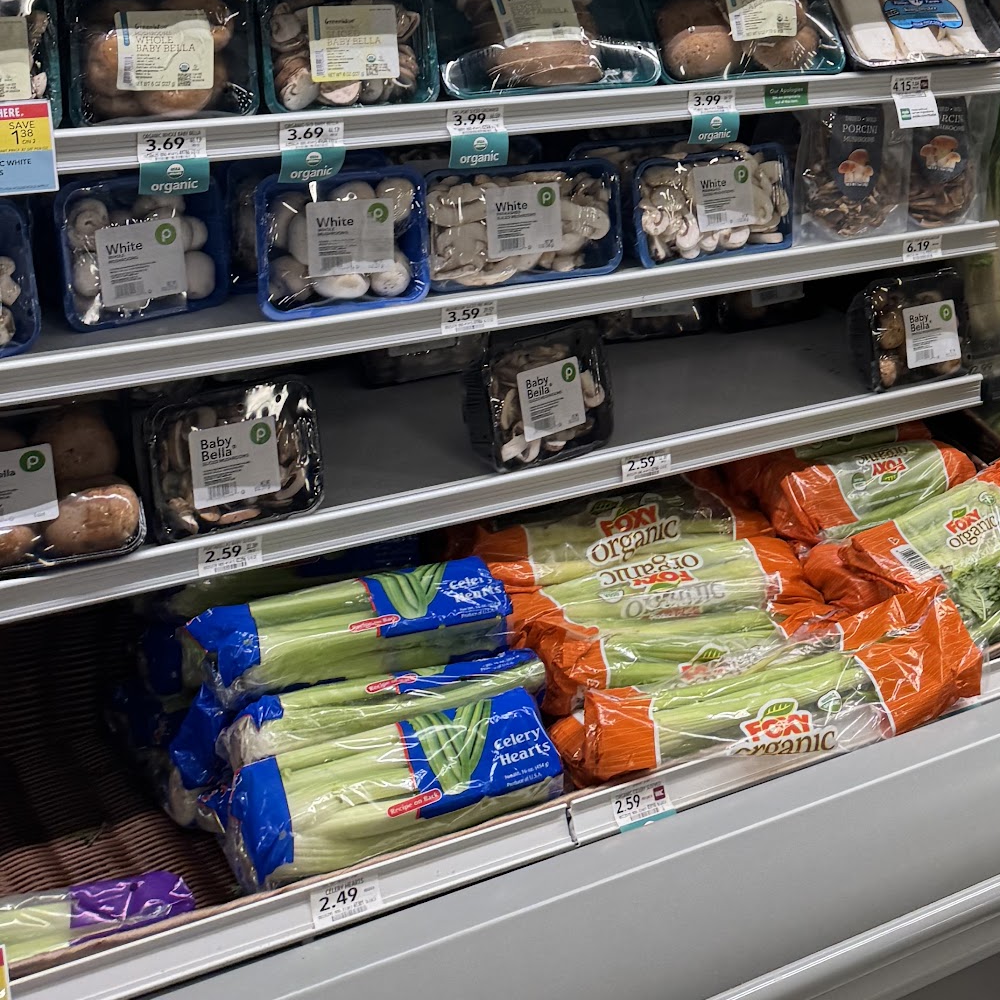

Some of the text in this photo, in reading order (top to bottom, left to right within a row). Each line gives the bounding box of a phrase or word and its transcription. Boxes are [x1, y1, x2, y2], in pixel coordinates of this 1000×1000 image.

[136, 36, 174, 44] WHOLE
[136, 43, 196, 52] BABY BELLA
[693, 95, 721, 106] 3.99
[9, 120, 35, 130] SAVE
[453, 113, 486, 126] 3.99
[287, 126, 324, 141] 3.69
[698, 129, 731, 141] organic
[842, 124, 878, 134] PORCINI
[145, 136, 185, 152] 3.69
[6, 158, 31, 166] WHITE
[459, 150, 500, 165] organic
[290, 166, 332, 180] organic
[150, 177, 198, 193] organic
[701, 178, 726, 189] White
[495, 200, 528, 212] White
[316, 216, 354, 228] White
[106, 240, 143, 256] White
[907, 241, 930, 253] 6.19
[447, 308, 480, 323] 3.59
[909, 314, 929, 324] Baby
[911, 323, 930, 332] Bella
[526, 375, 549, 389] Baby
[527, 386, 550, 399] Bella
[200, 437, 232, 451] Baby
[201, 448, 232, 462] Bella
[628, 456, 656, 472] 2.59
[873, 458, 907, 476] FOXY
[600, 505, 657, 538] FOXY
[946, 509, 981, 534] FOXY
[949, 516, 1000, 548] organic
[592, 519, 678, 562] organic
[205, 545, 242, 563] 2.59
[449, 575, 492, 591] Celery
[745, 714, 809, 742] FOXY
[494, 727, 541, 751] Celery
[499, 742, 551, 767] Hearts
[390, 804, 412, 816] Recipe
[423, 792, 440, 802] Back
[615, 794, 640, 814] 2.59
[319, 887, 358, 912] 2.49
